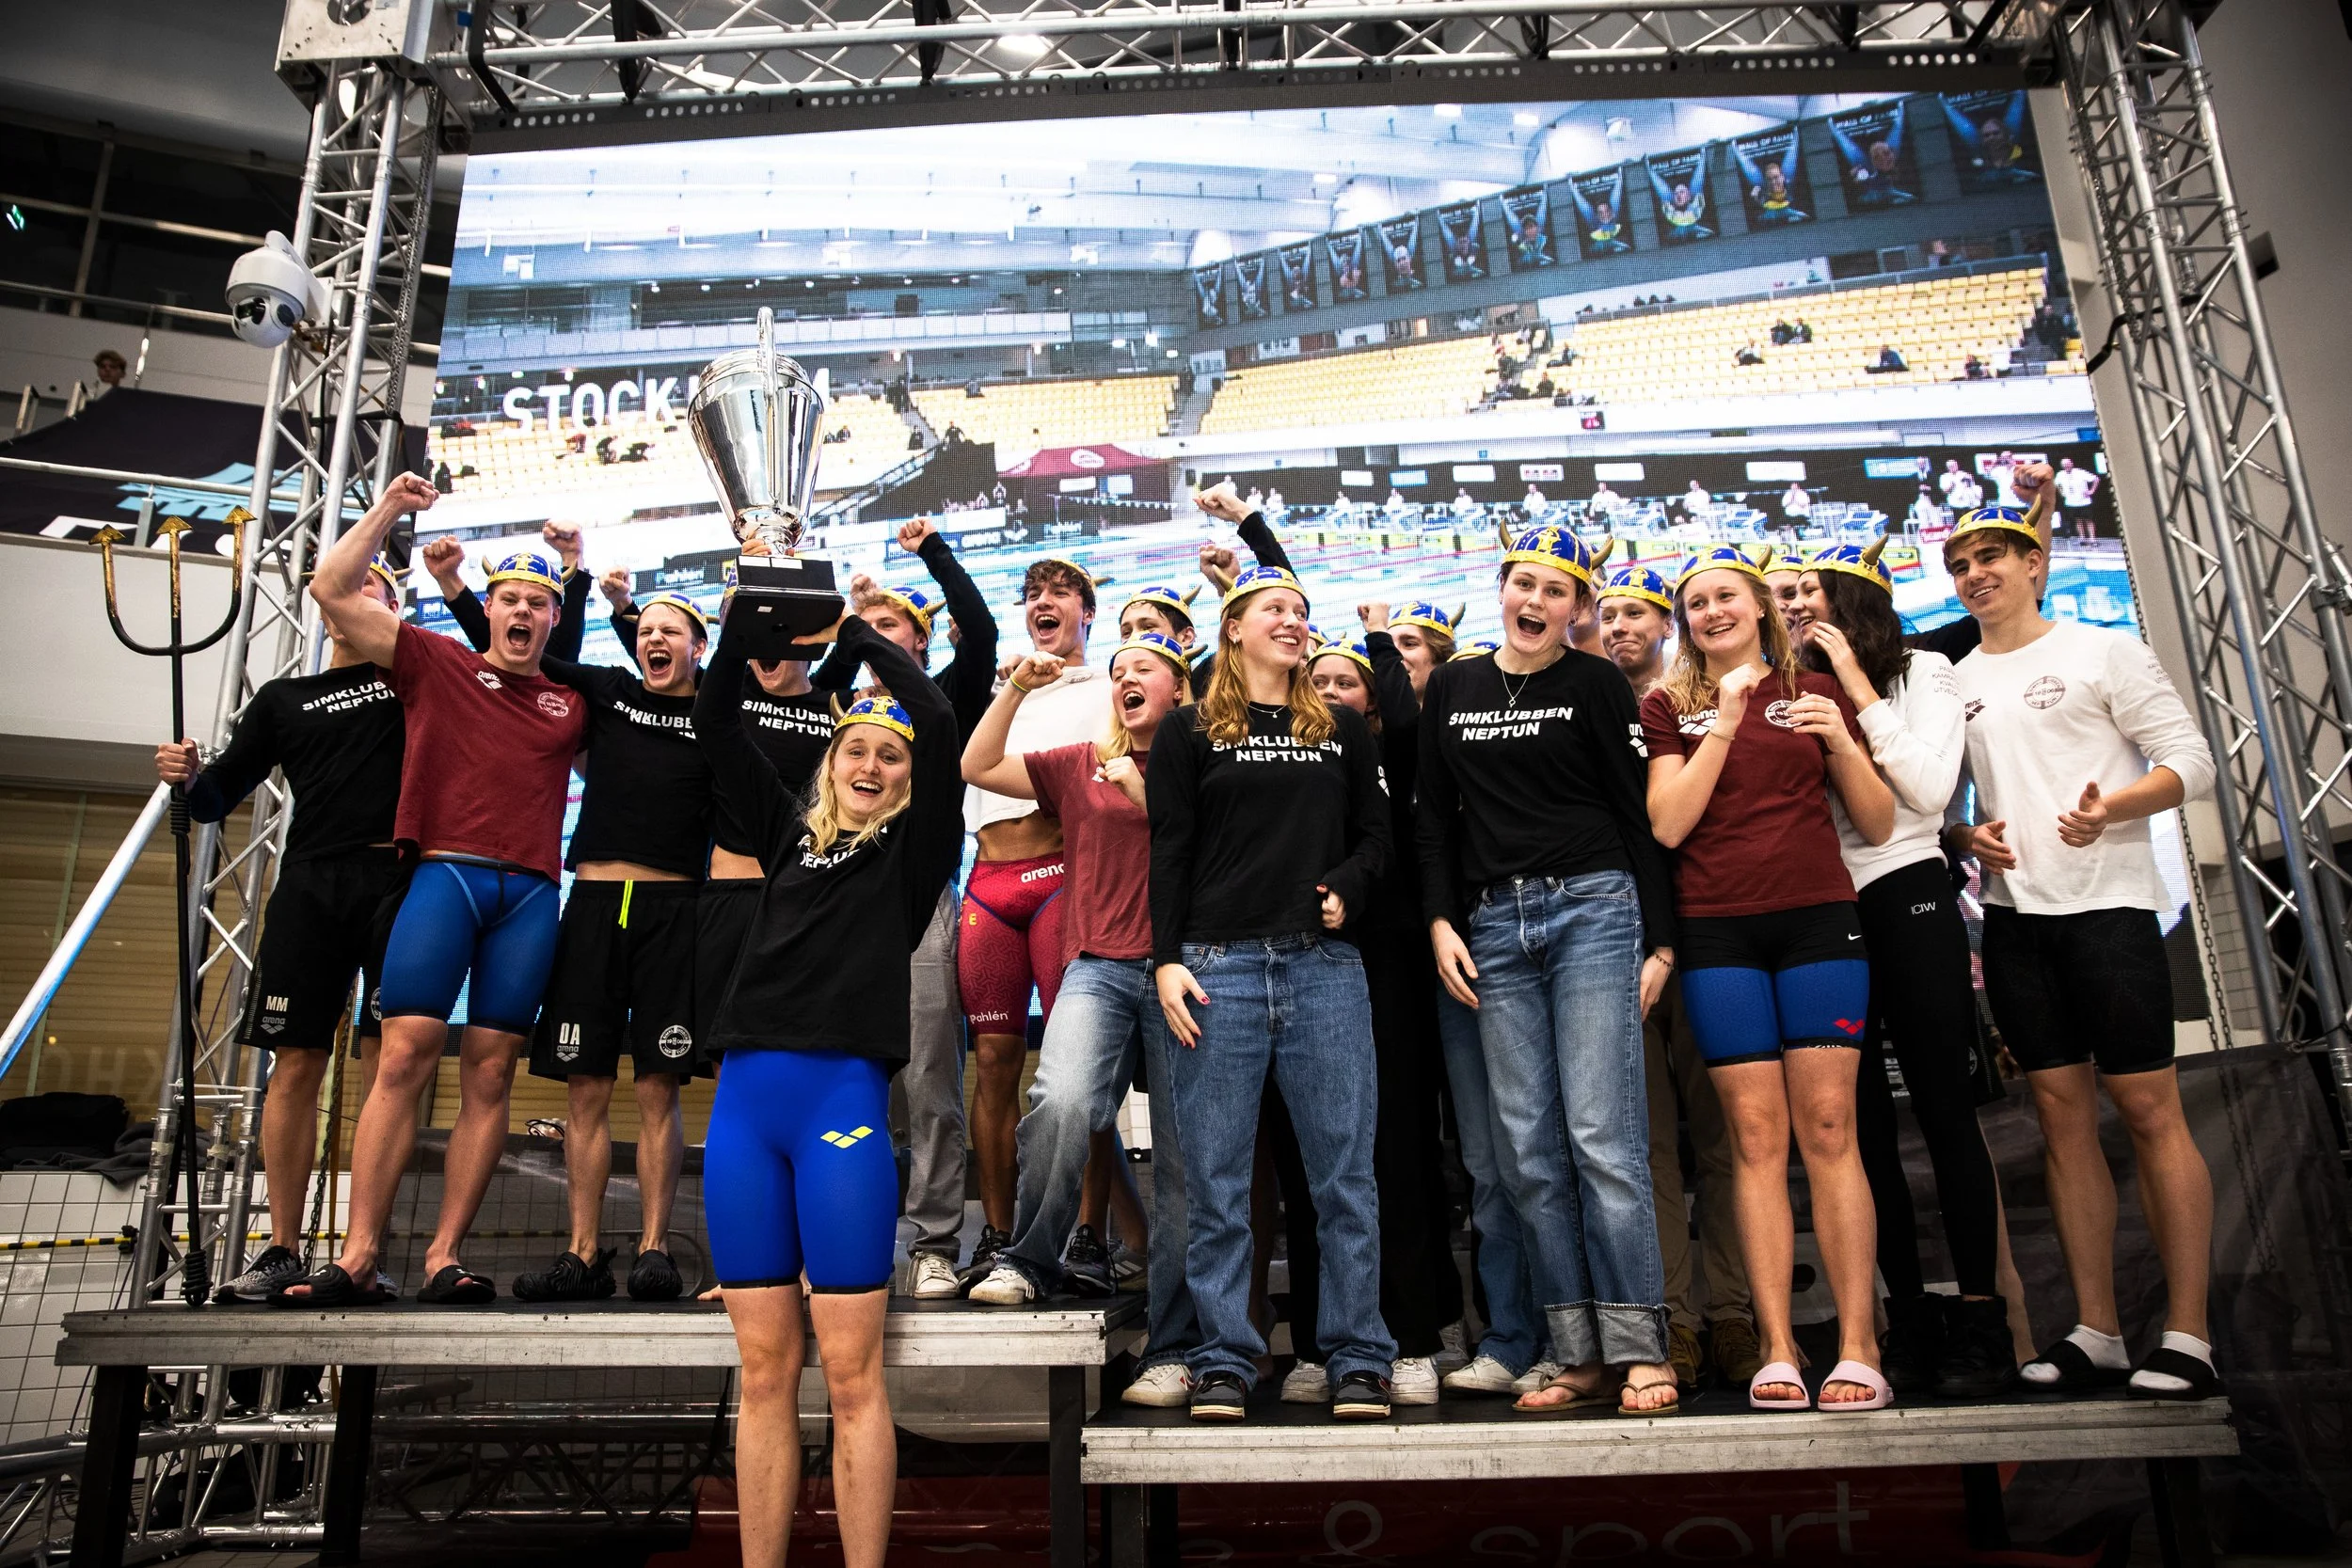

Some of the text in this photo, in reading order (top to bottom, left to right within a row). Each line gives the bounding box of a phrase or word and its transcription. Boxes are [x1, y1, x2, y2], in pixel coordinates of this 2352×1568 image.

[301, 681, 387, 711] SIMKLUB
[1964, 698, 1982, 709] rena
[613, 700, 693, 729] SIMKLUBB
[741, 699, 836, 726] SIMKLUBB
[1448, 707, 1574, 726] SIMKLUBBEN
[758, 716, 832, 738] NEPTUN
[1462, 722, 1541, 741] NEPTUN
[1629, 723, 1645, 736] are
[1212, 736, 1343, 757] SIKLUBEN
[1235, 750, 1323, 763] NEPTUN
[1911, 901, 1936, 915] ICIW
[265, 995, 289, 1012] MM
[262, 1015, 286, 1025] arena
[969, 1011, 1009, 1024] Pahlén
